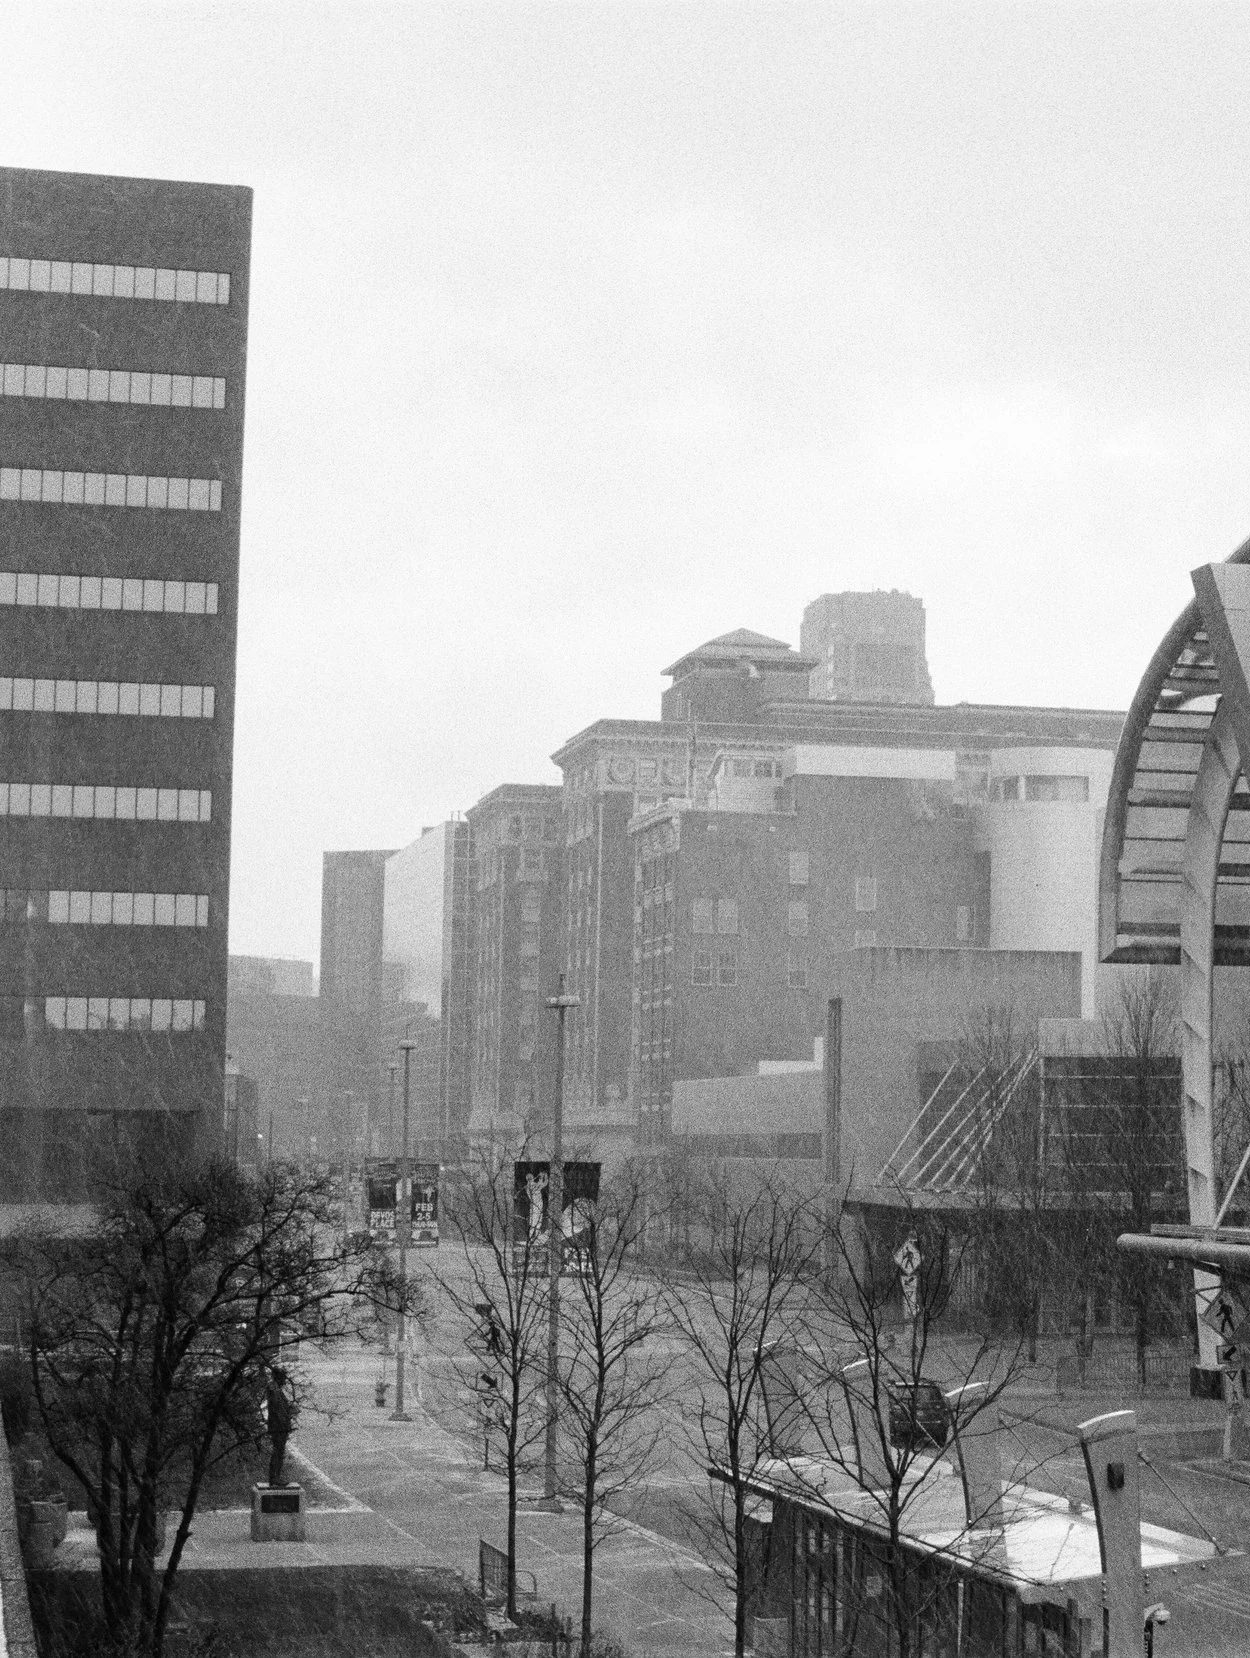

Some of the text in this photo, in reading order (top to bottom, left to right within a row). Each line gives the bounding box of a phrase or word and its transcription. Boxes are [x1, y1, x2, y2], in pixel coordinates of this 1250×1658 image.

[415, 1203, 433, 1212] FEB
[416, 1212, 431, 1221] 2-5
[370, 1219, 395, 1228] PLACE
